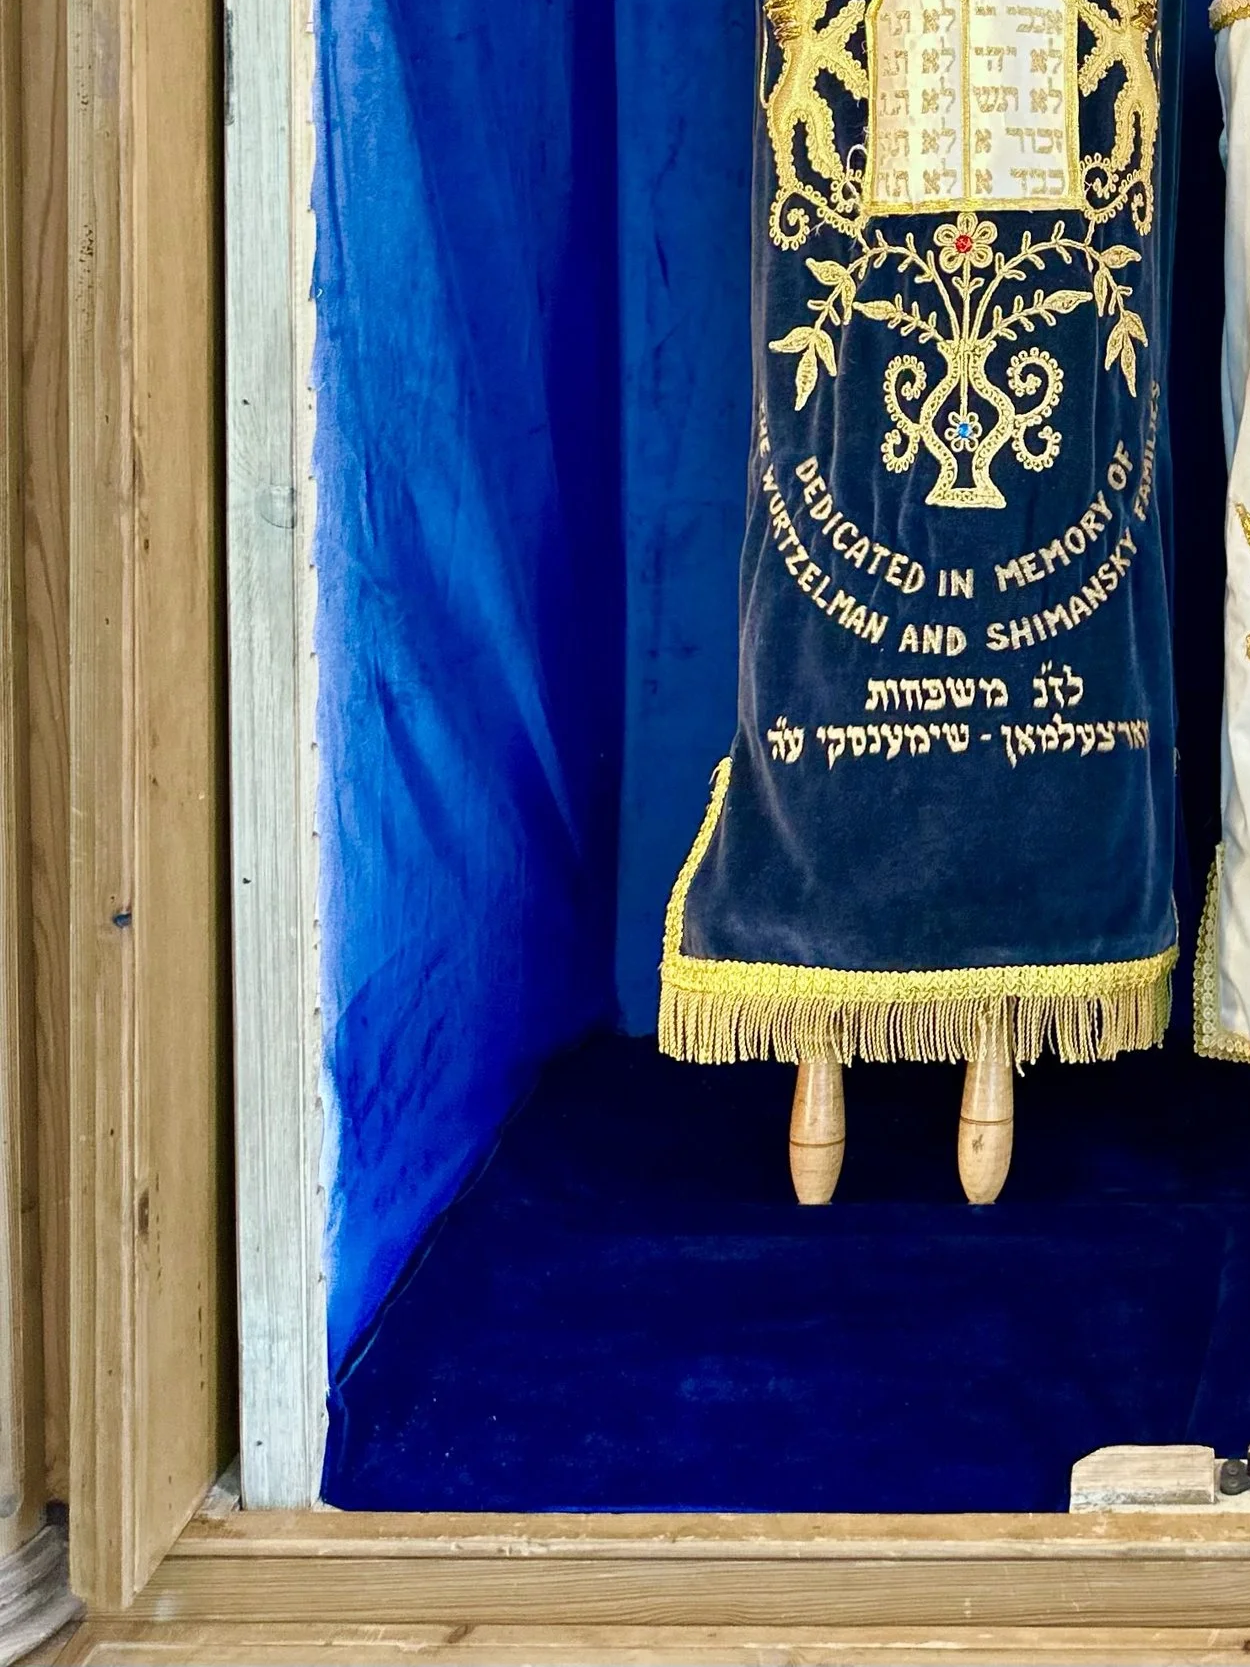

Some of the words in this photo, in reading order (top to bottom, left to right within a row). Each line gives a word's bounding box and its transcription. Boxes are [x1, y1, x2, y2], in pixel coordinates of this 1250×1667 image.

[762, 463, 889, 644] WURTZELMAN
[899, 625, 966, 656] AND
[986, 528, 1139, 651] SHIMANSKY
[795, 455, 925, 595] DEDICATED
[938, 569, 974, 599] IN
[995, 491, 1113, 593] MEMORY
[1107, 440, 1133, 490] OF
[865, 677, 1008, 711] משפחות
[816, 723, 969, 770] שימענסקי
